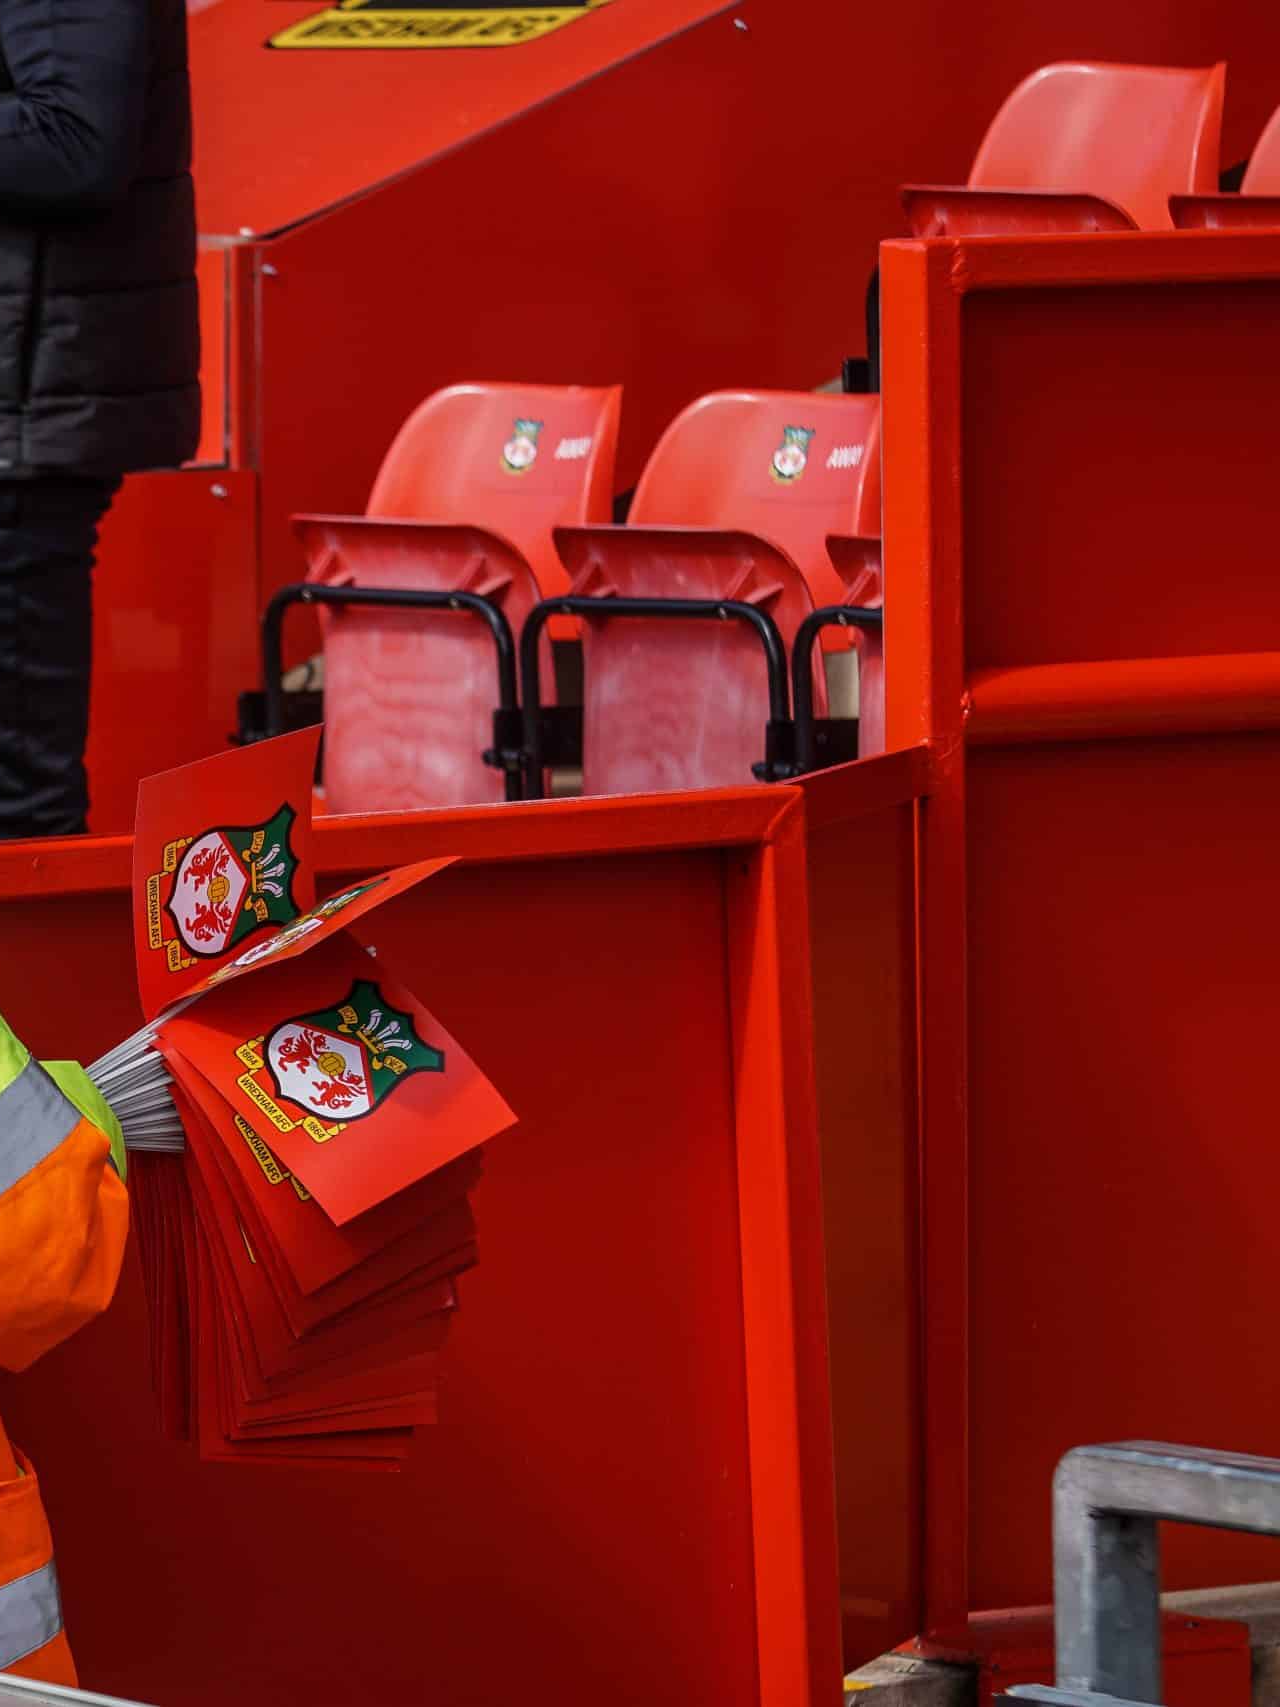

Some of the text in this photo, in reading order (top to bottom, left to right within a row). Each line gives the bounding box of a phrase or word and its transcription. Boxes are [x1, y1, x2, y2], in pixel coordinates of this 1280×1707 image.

[239, 1075, 292, 1131] WREXHAM AFC
[263, 1161, 281, 1182] AFC
